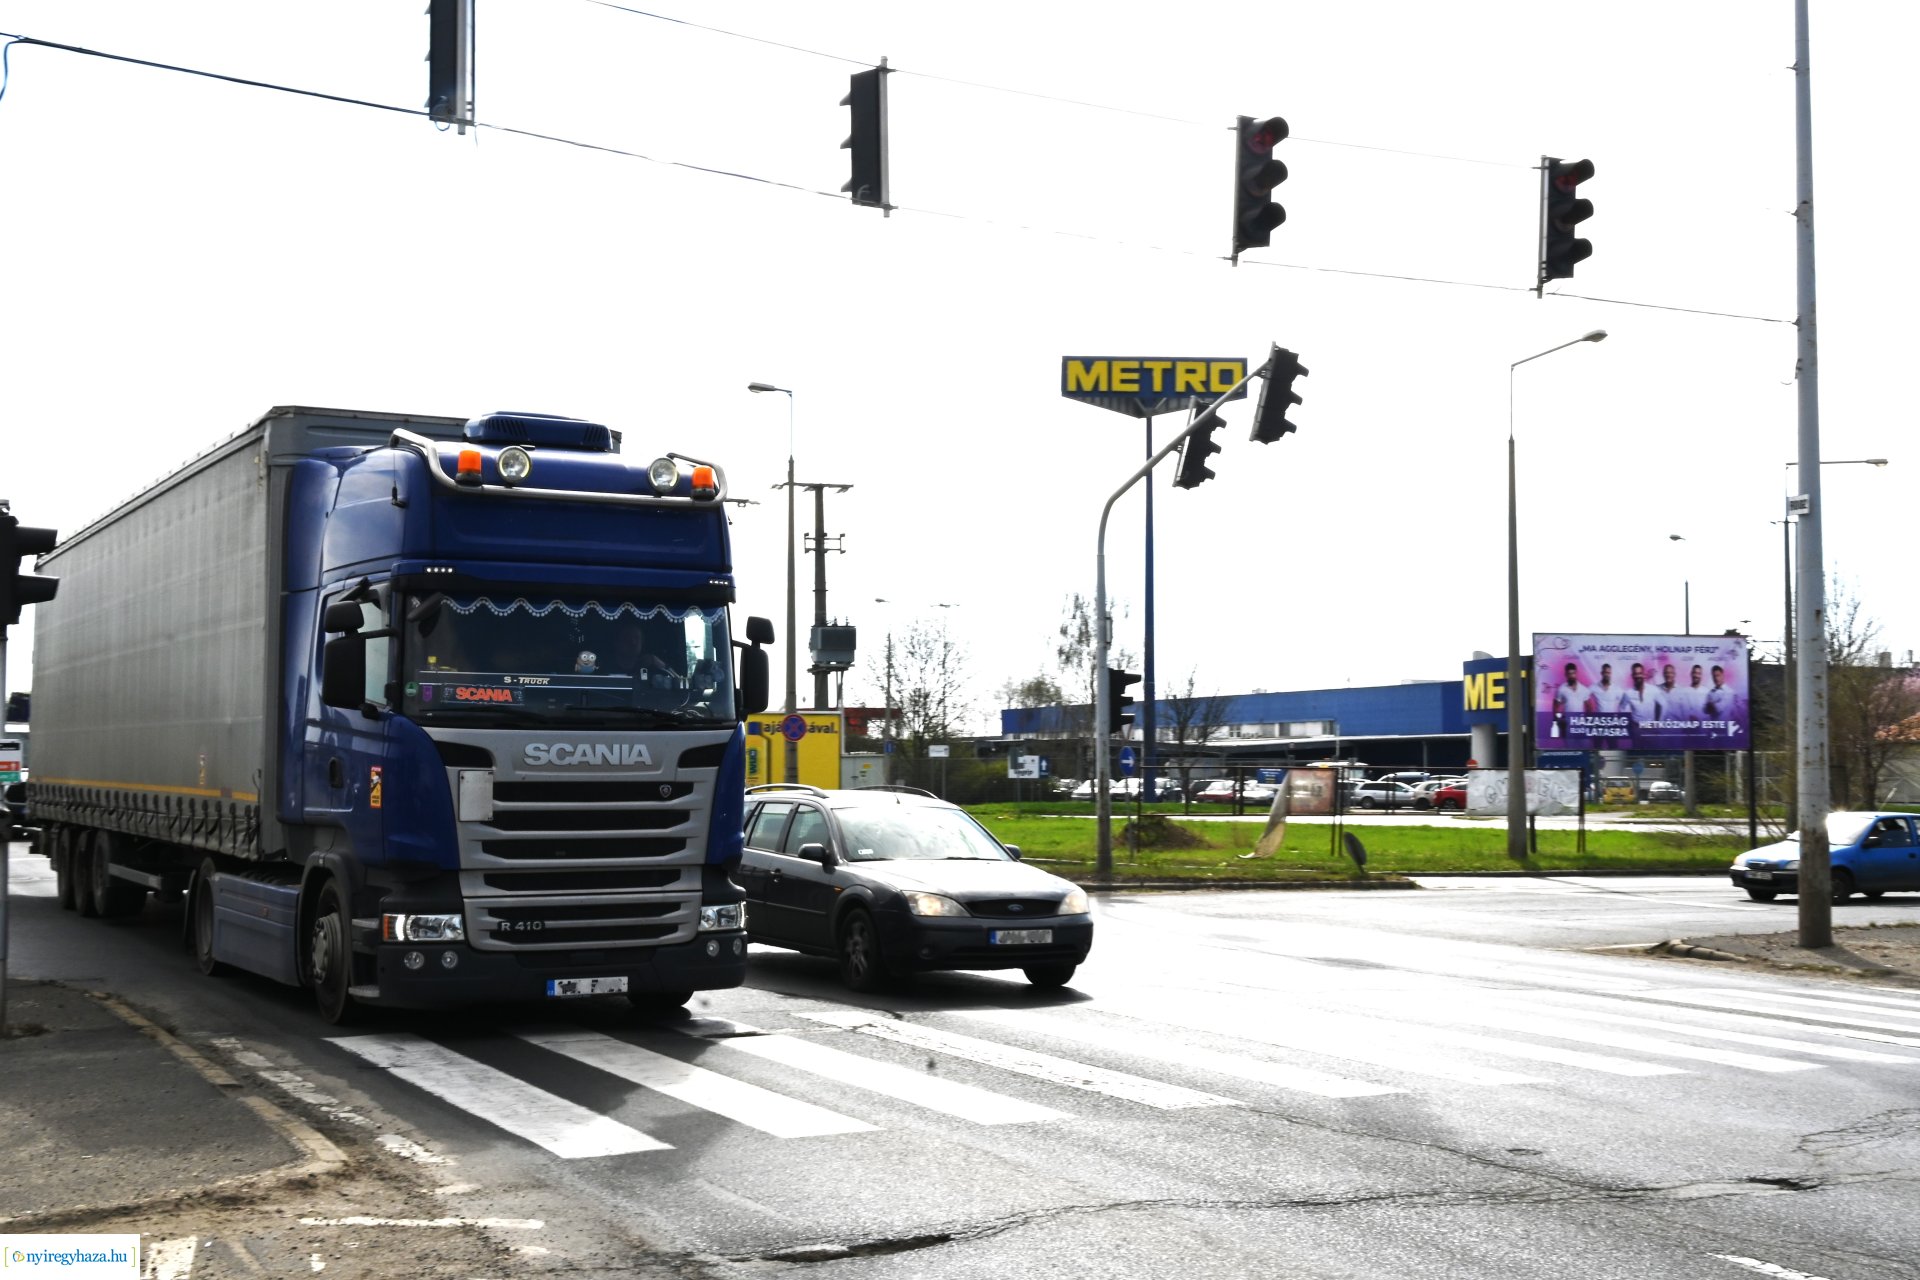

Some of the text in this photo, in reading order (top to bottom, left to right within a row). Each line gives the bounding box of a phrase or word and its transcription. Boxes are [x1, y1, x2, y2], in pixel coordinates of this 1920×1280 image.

[1066, 359, 1244, 393] METRO
[1655, 645, 1692, 653] HOLNAP
[455, 687, 513, 702] SCANIA
[1702, 720, 1726, 729] ESTE
[524, 743, 653, 766] SCANIA
[501, 921, 542, 931] R 410
